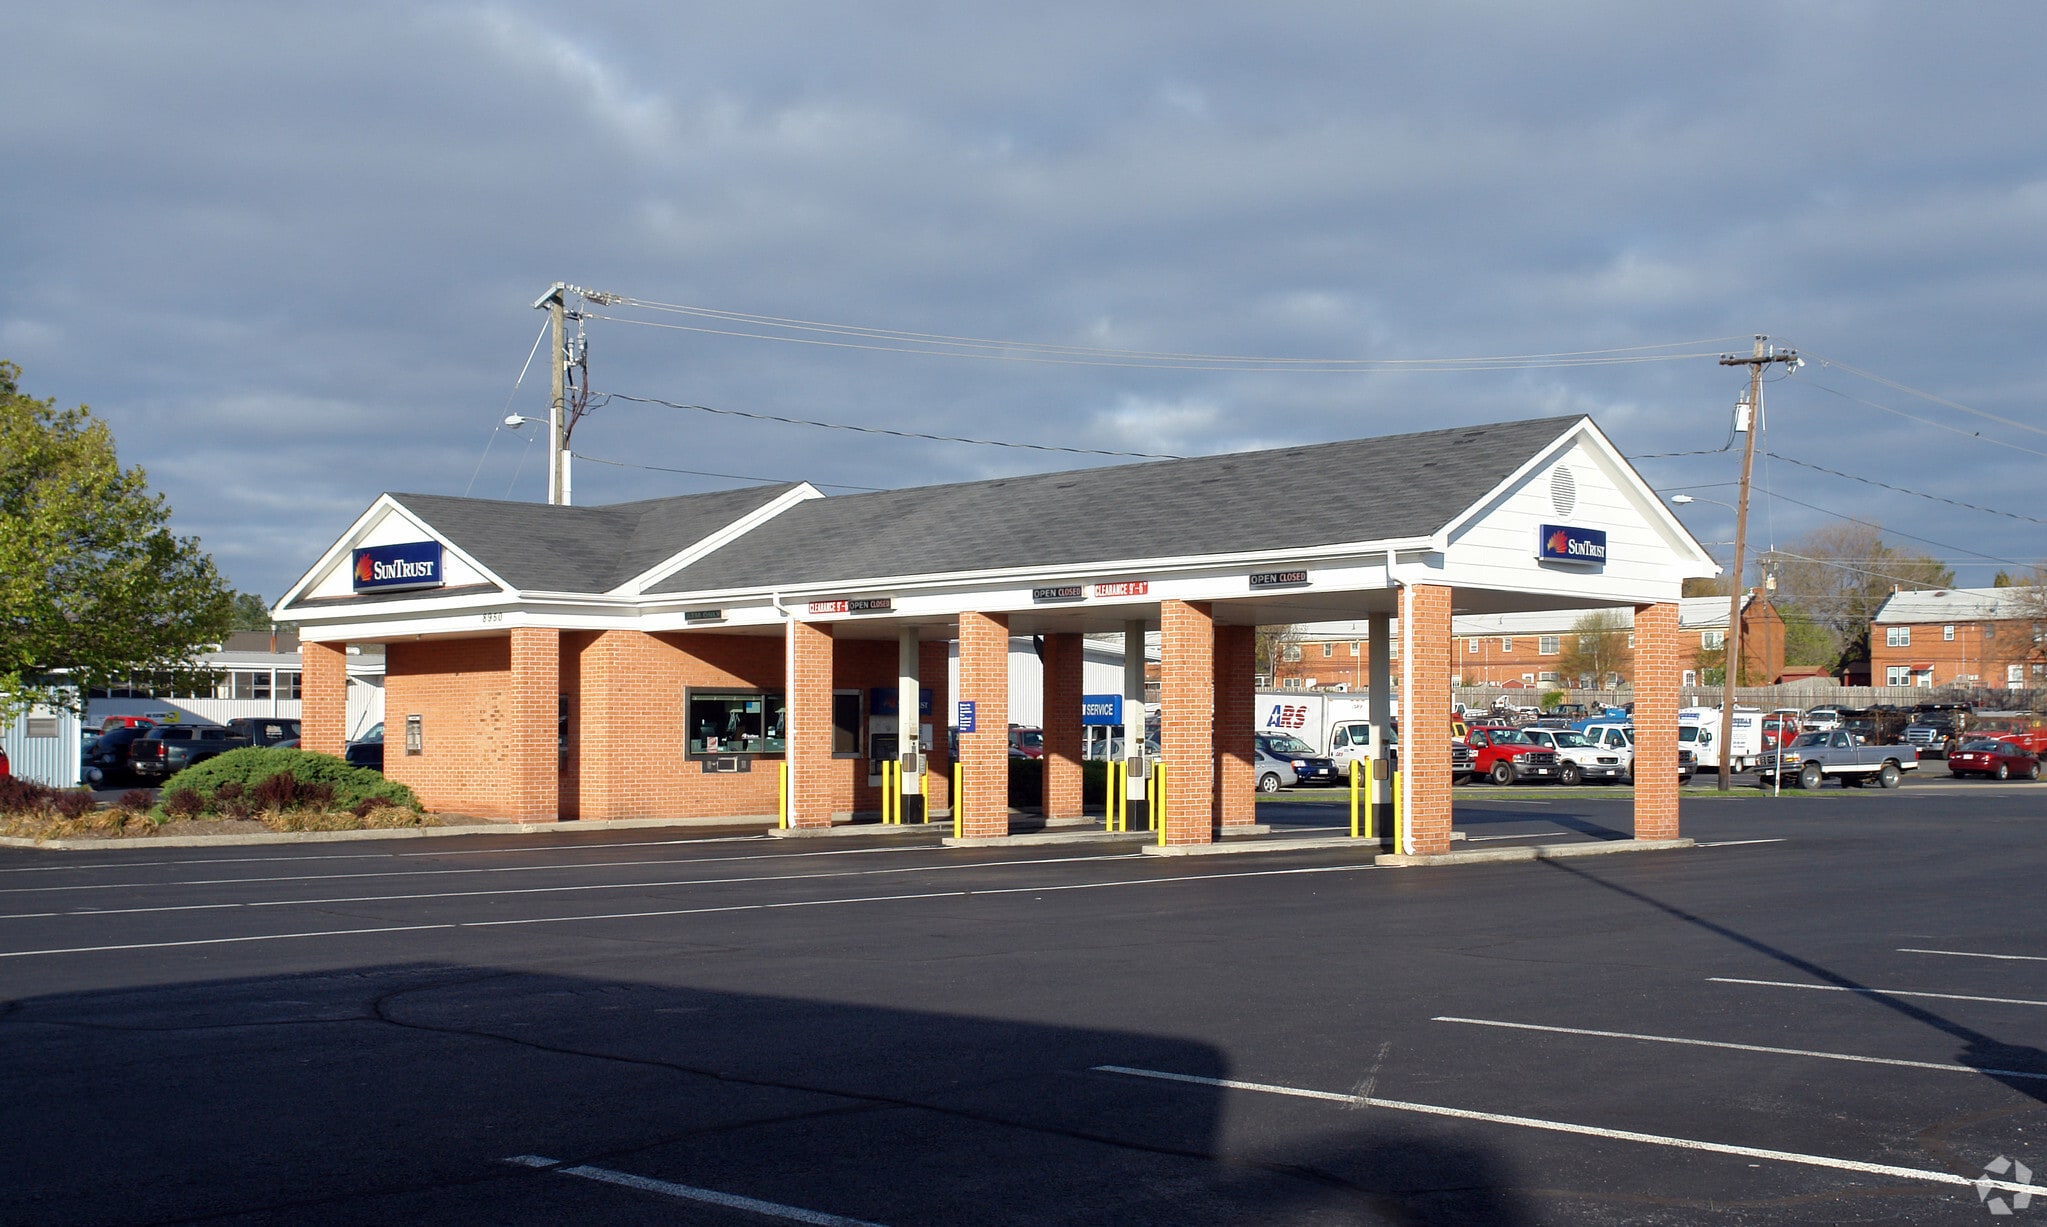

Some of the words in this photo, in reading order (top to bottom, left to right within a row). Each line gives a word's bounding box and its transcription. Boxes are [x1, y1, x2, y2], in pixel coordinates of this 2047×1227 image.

[1568, 539, 1605, 558] SUNTRUST
[374, 560, 433, 580] SUNTRUST
[1251, 574, 1277, 584] OPEN
[1279, 572, 1306, 582] CLOSED
[1033, 589, 1057, 598] OPEN
[1058, 587, 1081, 597] CLOSED
[1095, 584, 1128, 597] CLEARANCE
[809, 602, 836, 613] CLEARANCE
[849, 601, 869, 610] OPEN
[870, 600, 890, 608] CLOSED
[1086, 703, 1114, 716] SERVICE
[1266, 704, 1308, 729] ARS
